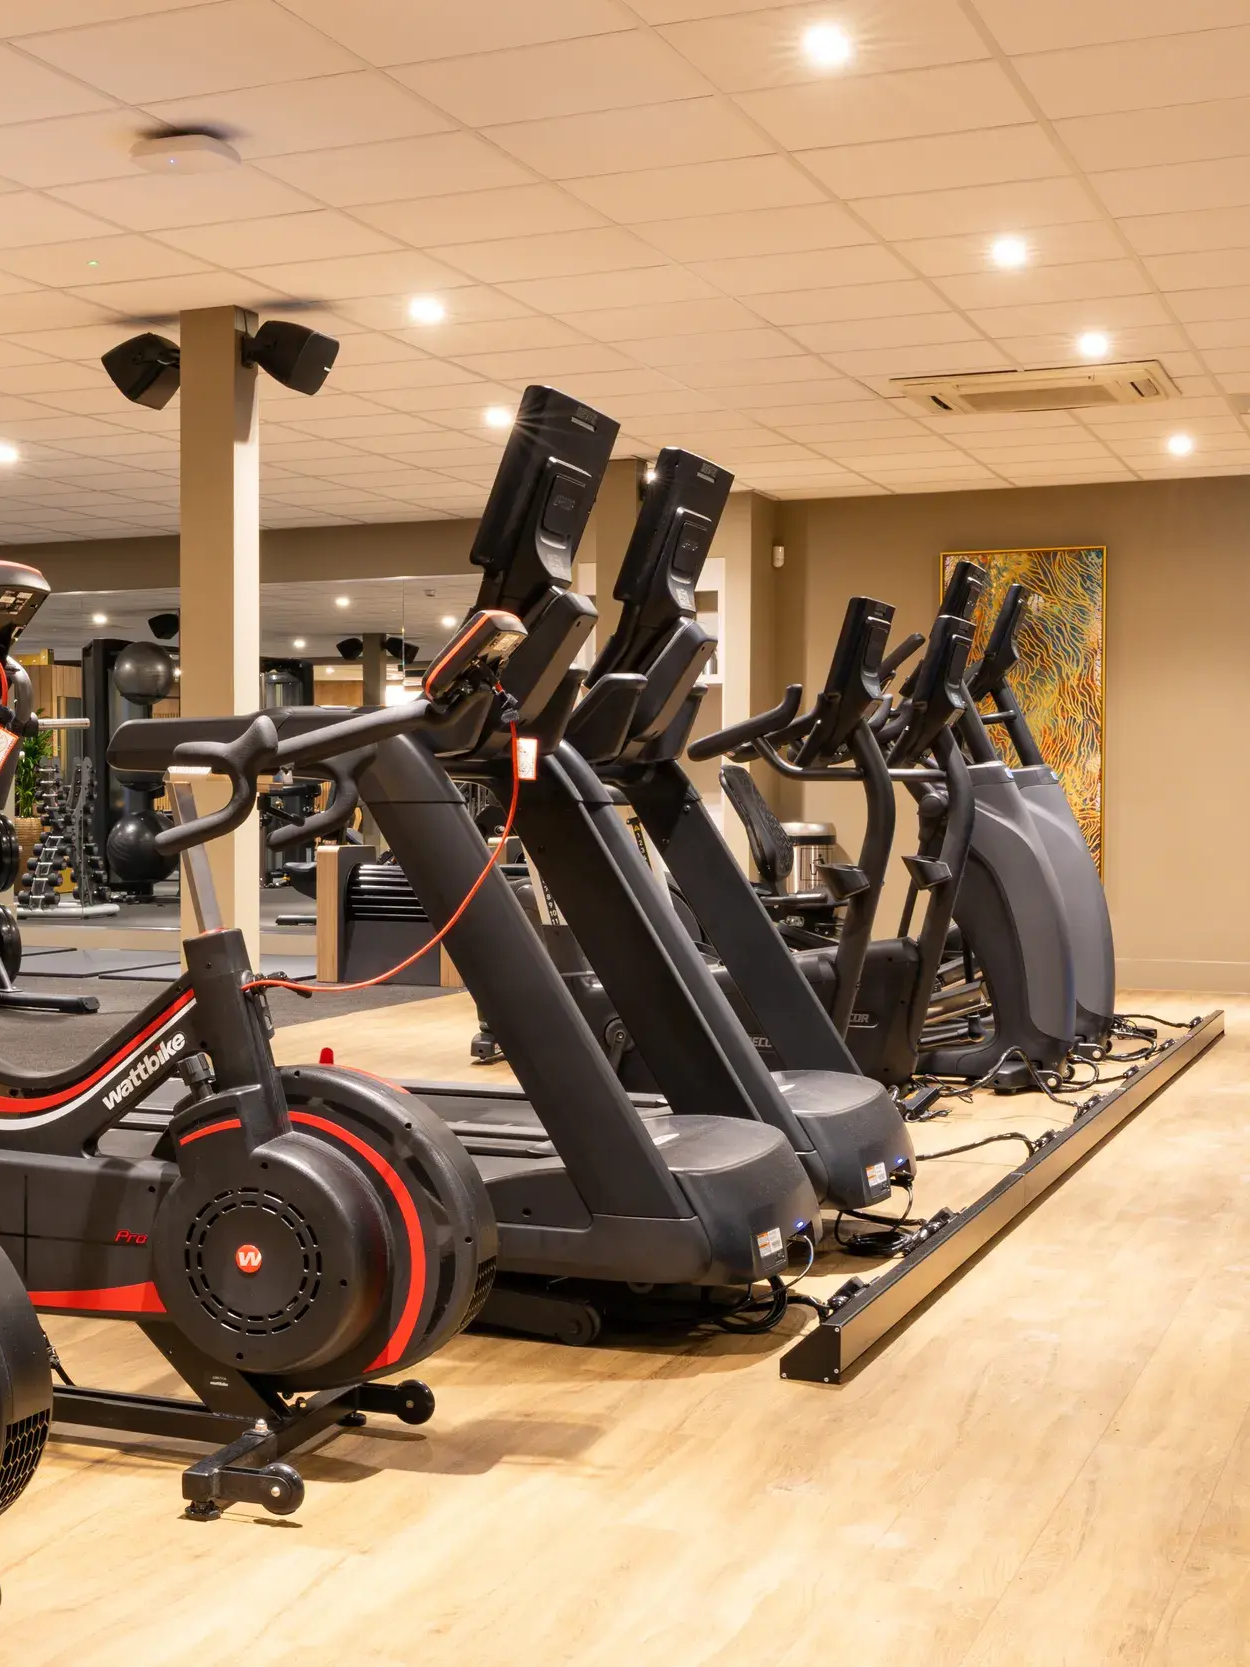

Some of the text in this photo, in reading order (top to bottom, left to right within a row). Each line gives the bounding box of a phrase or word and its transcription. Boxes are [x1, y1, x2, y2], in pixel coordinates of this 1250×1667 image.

[549, 909, 557, 917] 10
[102, 1033, 186, 1110] wattbike
[114, 1229, 148, 1244] Pro
